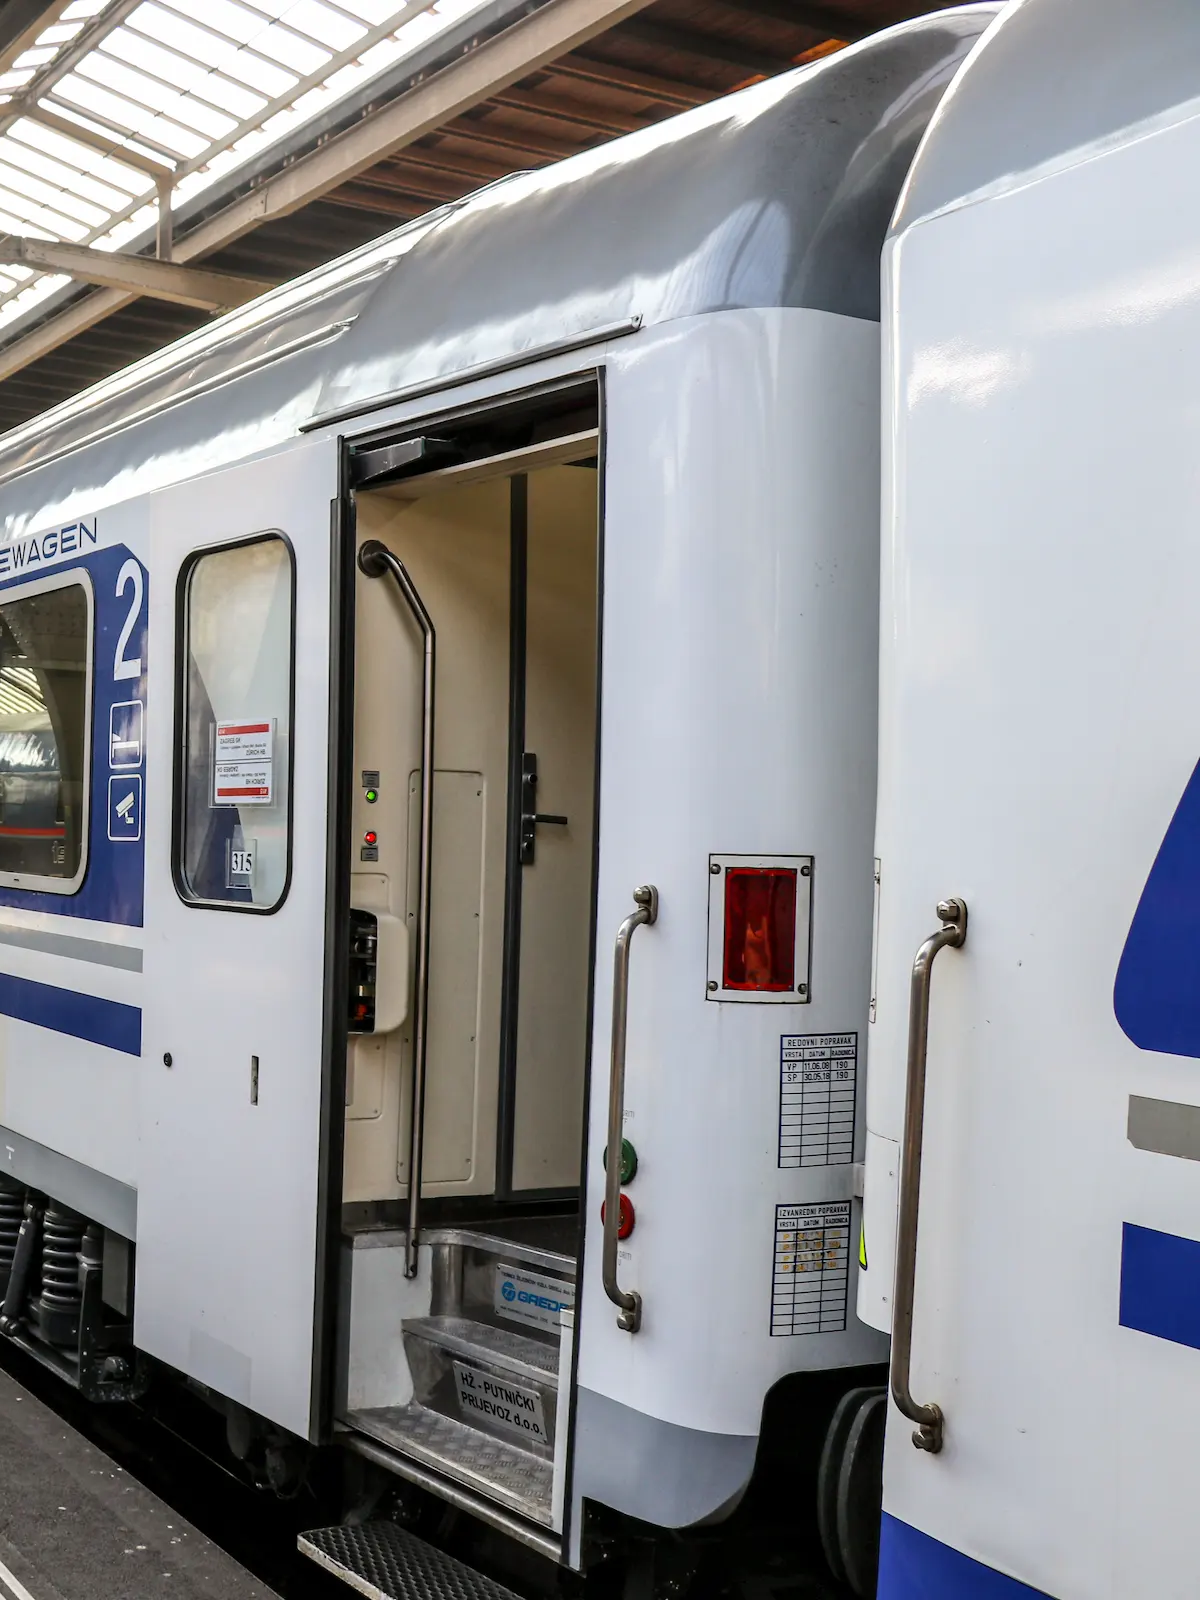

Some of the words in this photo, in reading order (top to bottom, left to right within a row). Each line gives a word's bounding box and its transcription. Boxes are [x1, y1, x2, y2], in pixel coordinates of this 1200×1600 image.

[114, 558, 143, 681] 2
[232, 853, 252, 872] 315
[787, 1038, 817, 1047] REDOVNI
[820, 1037, 852, 1046] POPRAVAK
[787, 1063, 797, 1071] VP
[836, 1060, 848, 1069] 190
[787, 1073, 798, 1082] SP
[836, 1071, 848, 1079] 190
[779, 1208, 817, 1217] IZVANREDNI
[818, 1205, 848, 1214] POPRAVAK
[803, 1219, 820, 1227] DATUM
[460, 1372, 476, 1389] HŽ
[483, 1381, 535, 1412] PUTNIČKI
[461, 1390, 512, 1423] PRIJEVOZ
[514, 1413, 543, 1435] d.o.o.
